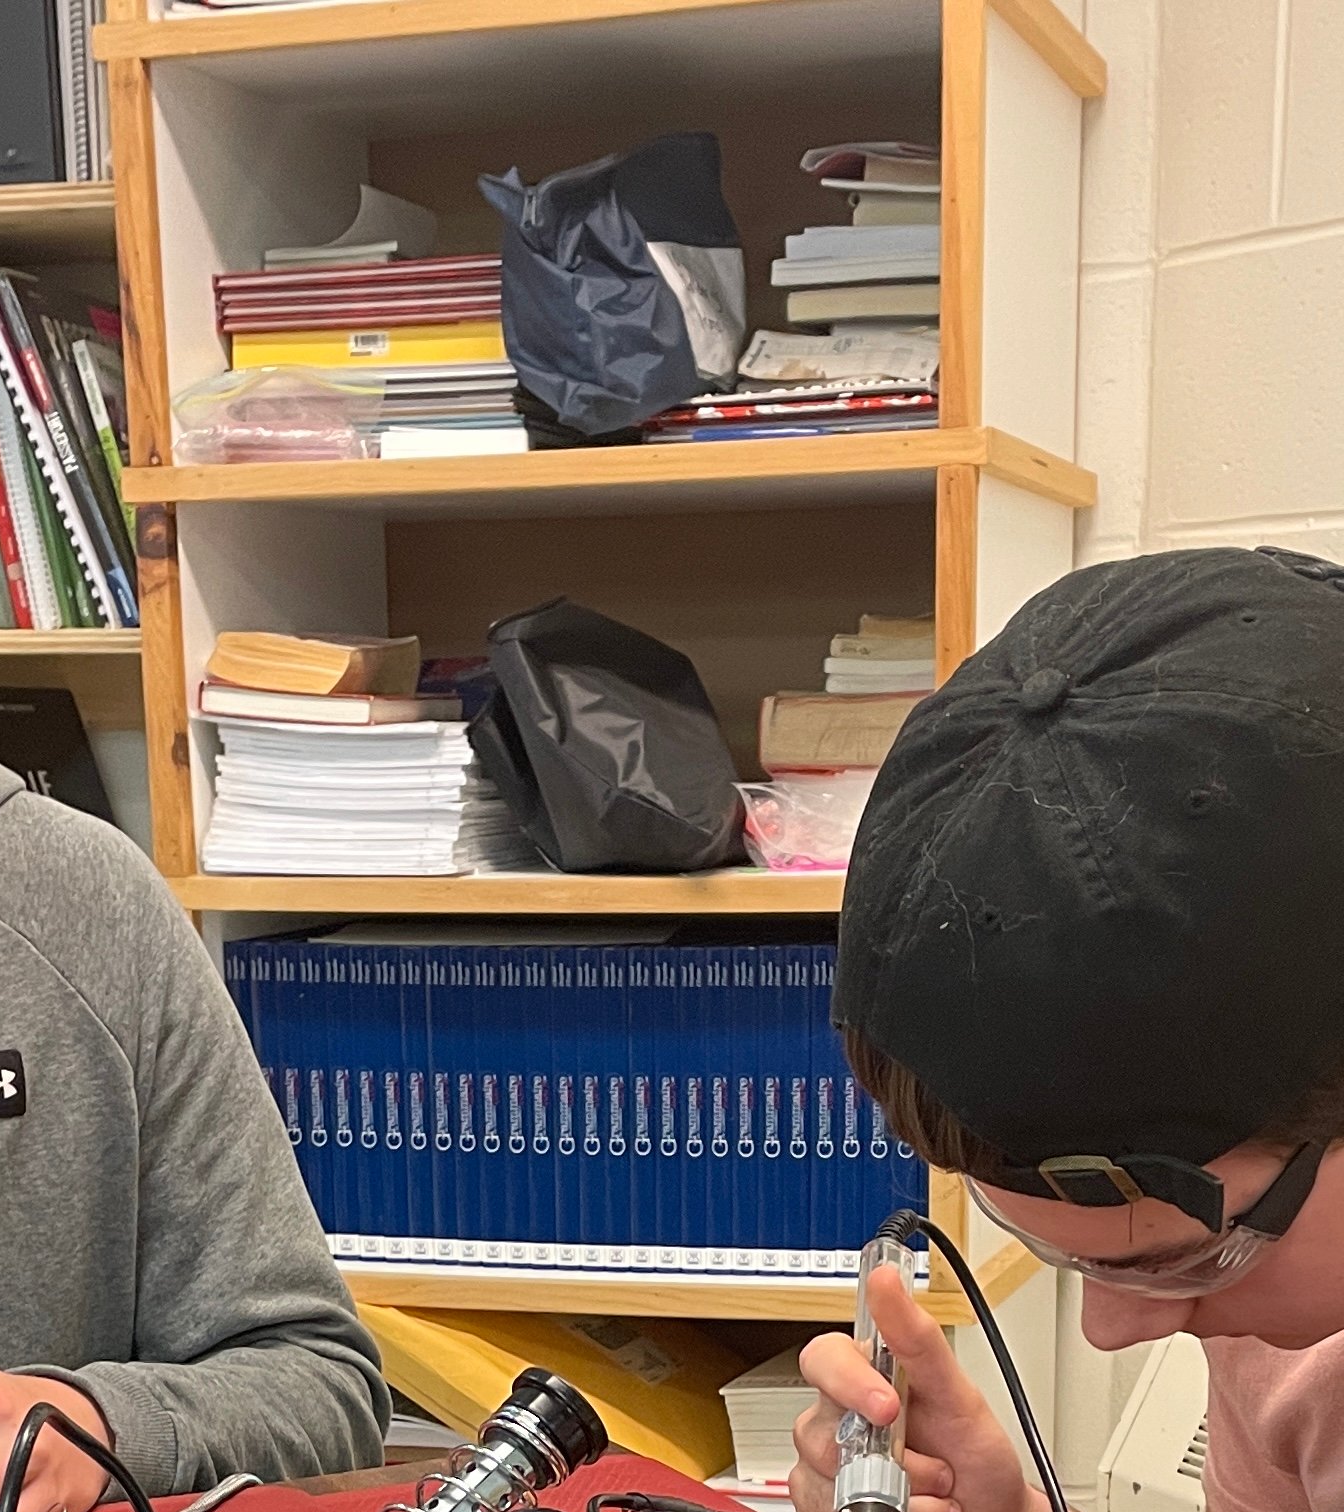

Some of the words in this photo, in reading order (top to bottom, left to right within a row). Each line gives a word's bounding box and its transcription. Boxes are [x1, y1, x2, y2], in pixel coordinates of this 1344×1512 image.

[309, 1070, 327, 1147] Grammaire
[335, 1070, 354, 1147] Grammaire
[359, 1071, 378, 1149] Grammaire
[384, 1071, 403, 1150] Grammaire
[408, 1072, 427, 1150] Grammaire
[433, 1073, 452, 1151] Grammaire
[457, 1073, 476, 1152] Grammaire
[482, 1074, 501, 1153] Grammaire
[506, 1074, 525, 1154] Grammaire
[531, 1075, 550, 1154] Grammaire
[556, 1076, 575, 1155] Grammaire
[582, 1076, 601, 1156] Grammaire
[607, 1077, 626, 1156] Grammaire
[632, 1077, 651, 1156] Grammaire
[658, 1077, 677, 1156] Grammaire
[684, 1077, 703, 1158] Grammaire
[709, 1077, 728, 1157] Grammaire
[735, 1077, 754, 1157] Grammaire
[762, 1077, 781, 1158] Grammaire
[787, 1077, 806, 1159] Grammaire
[814, 1077, 833, 1159] Grammaire
[840, 1077, 859, 1159] Grammaire
